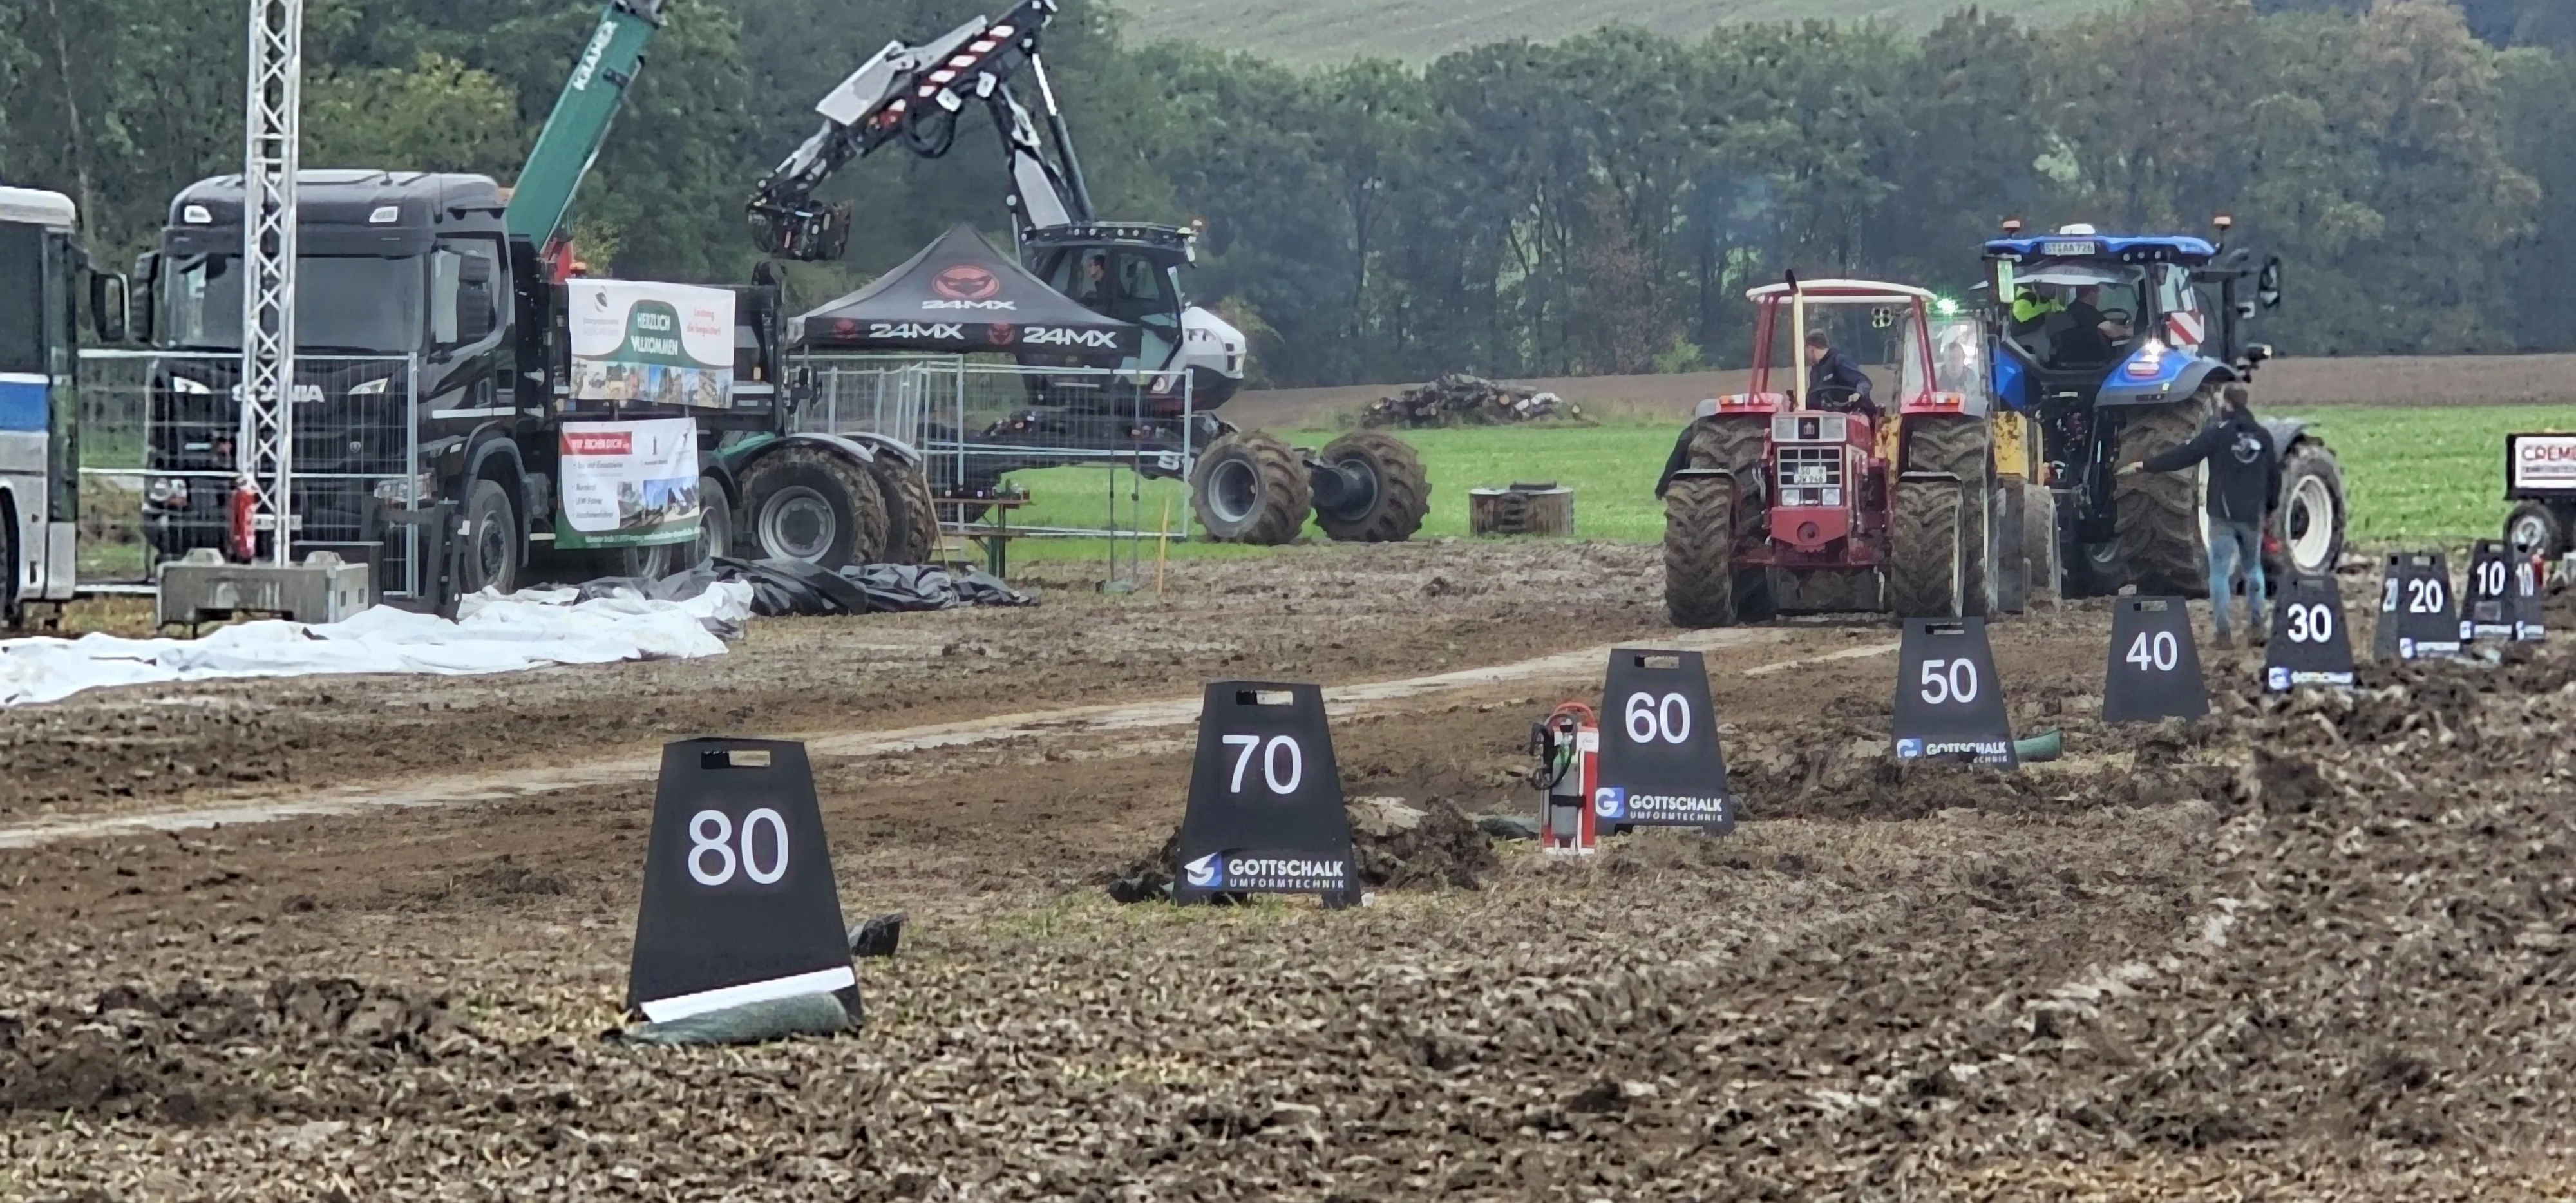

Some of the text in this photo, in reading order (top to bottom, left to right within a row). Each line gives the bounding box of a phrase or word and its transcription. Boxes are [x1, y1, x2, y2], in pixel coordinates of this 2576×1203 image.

[922, 300, 1017, 310] 24MX
[637, 312, 670, 331] HERZLICH
[869, 323, 965, 340] 24MX
[1023, 327, 1118, 348] 24MX
[2476, 560, 2506, 596] 10
[2408, 578, 2443, 613] 20
[2287, 603, 2331, 643] 30
[2126, 630, 2178, 672] 40
[1920, 658, 1978, 705] 50
[1625, 692, 1690, 744] 60
[1222, 734, 1302, 795] 70
[1629, 794, 1723, 812] GOTTSCHALK
[1630, 810, 1723, 822] UMFORMTECHNIK
[688, 808, 789, 886] 80
[1228, 858, 1344, 876] GOTTSCHALK
[1229, 878, 1345, 889] UMFORMTECHNIK
